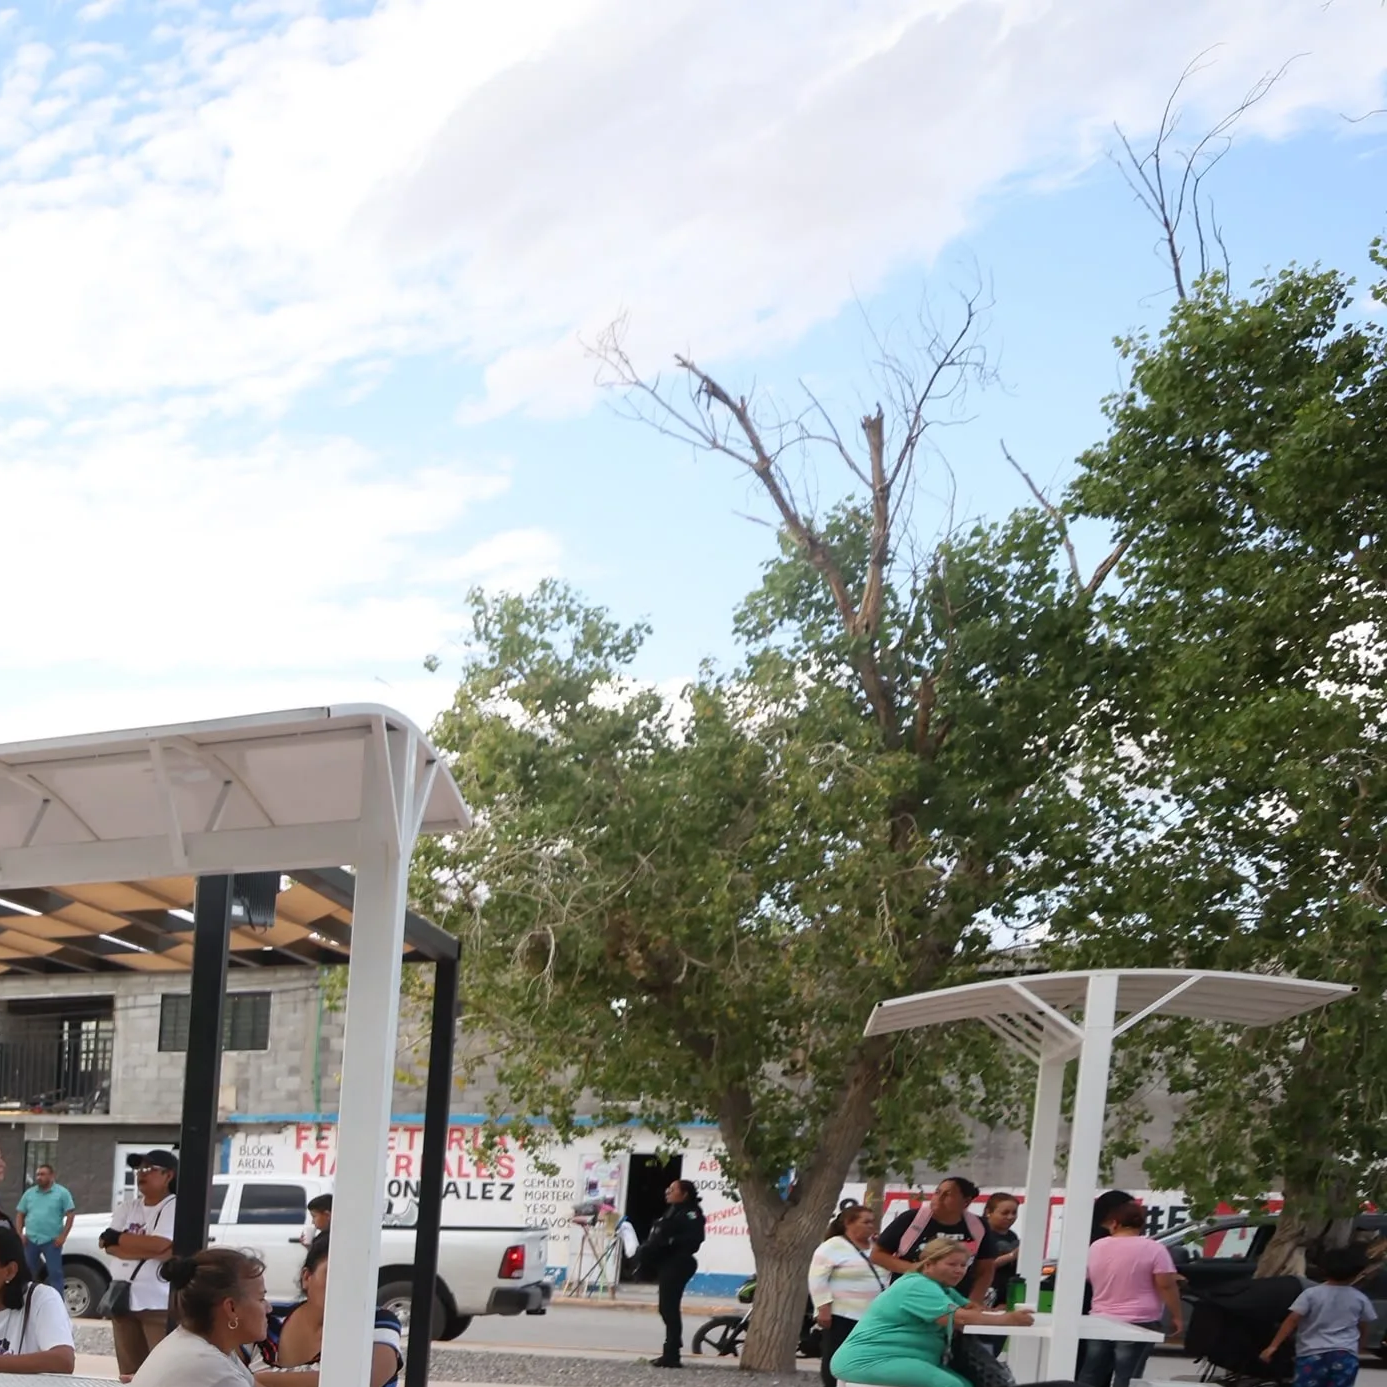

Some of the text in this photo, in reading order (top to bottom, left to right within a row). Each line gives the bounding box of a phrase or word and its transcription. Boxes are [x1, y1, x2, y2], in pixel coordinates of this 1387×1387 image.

[239, 1145, 274, 1157] BLOCK
[237, 1158, 275, 1170] ARENA
[387, 1179, 515, 1201] ONALEZ
[523, 1179, 575, 1189] CEMENTO
[524, 1203, 557, 1214] YESO
